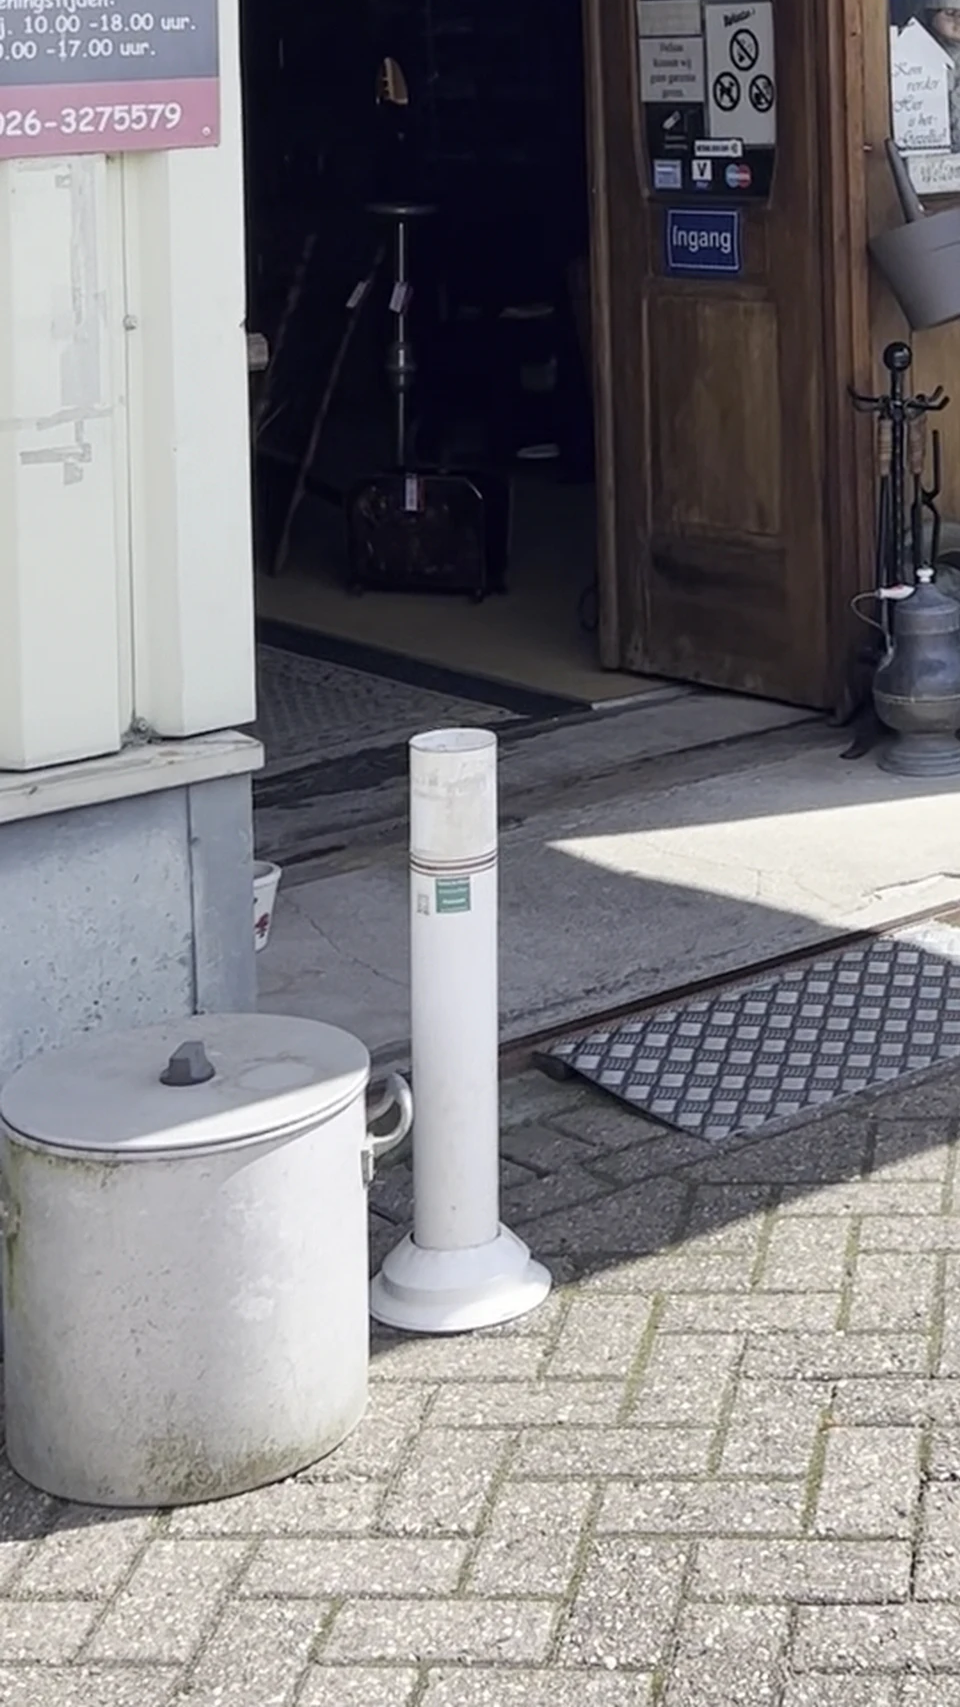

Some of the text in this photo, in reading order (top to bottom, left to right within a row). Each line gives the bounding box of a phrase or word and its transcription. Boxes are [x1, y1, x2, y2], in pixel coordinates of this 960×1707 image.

[24, 15, 81, 34] 10.00
[161, 16, 196, 31] uur.
[120, 42, 156, 57] uur.
[673, 224, 731, 253] Ingang
